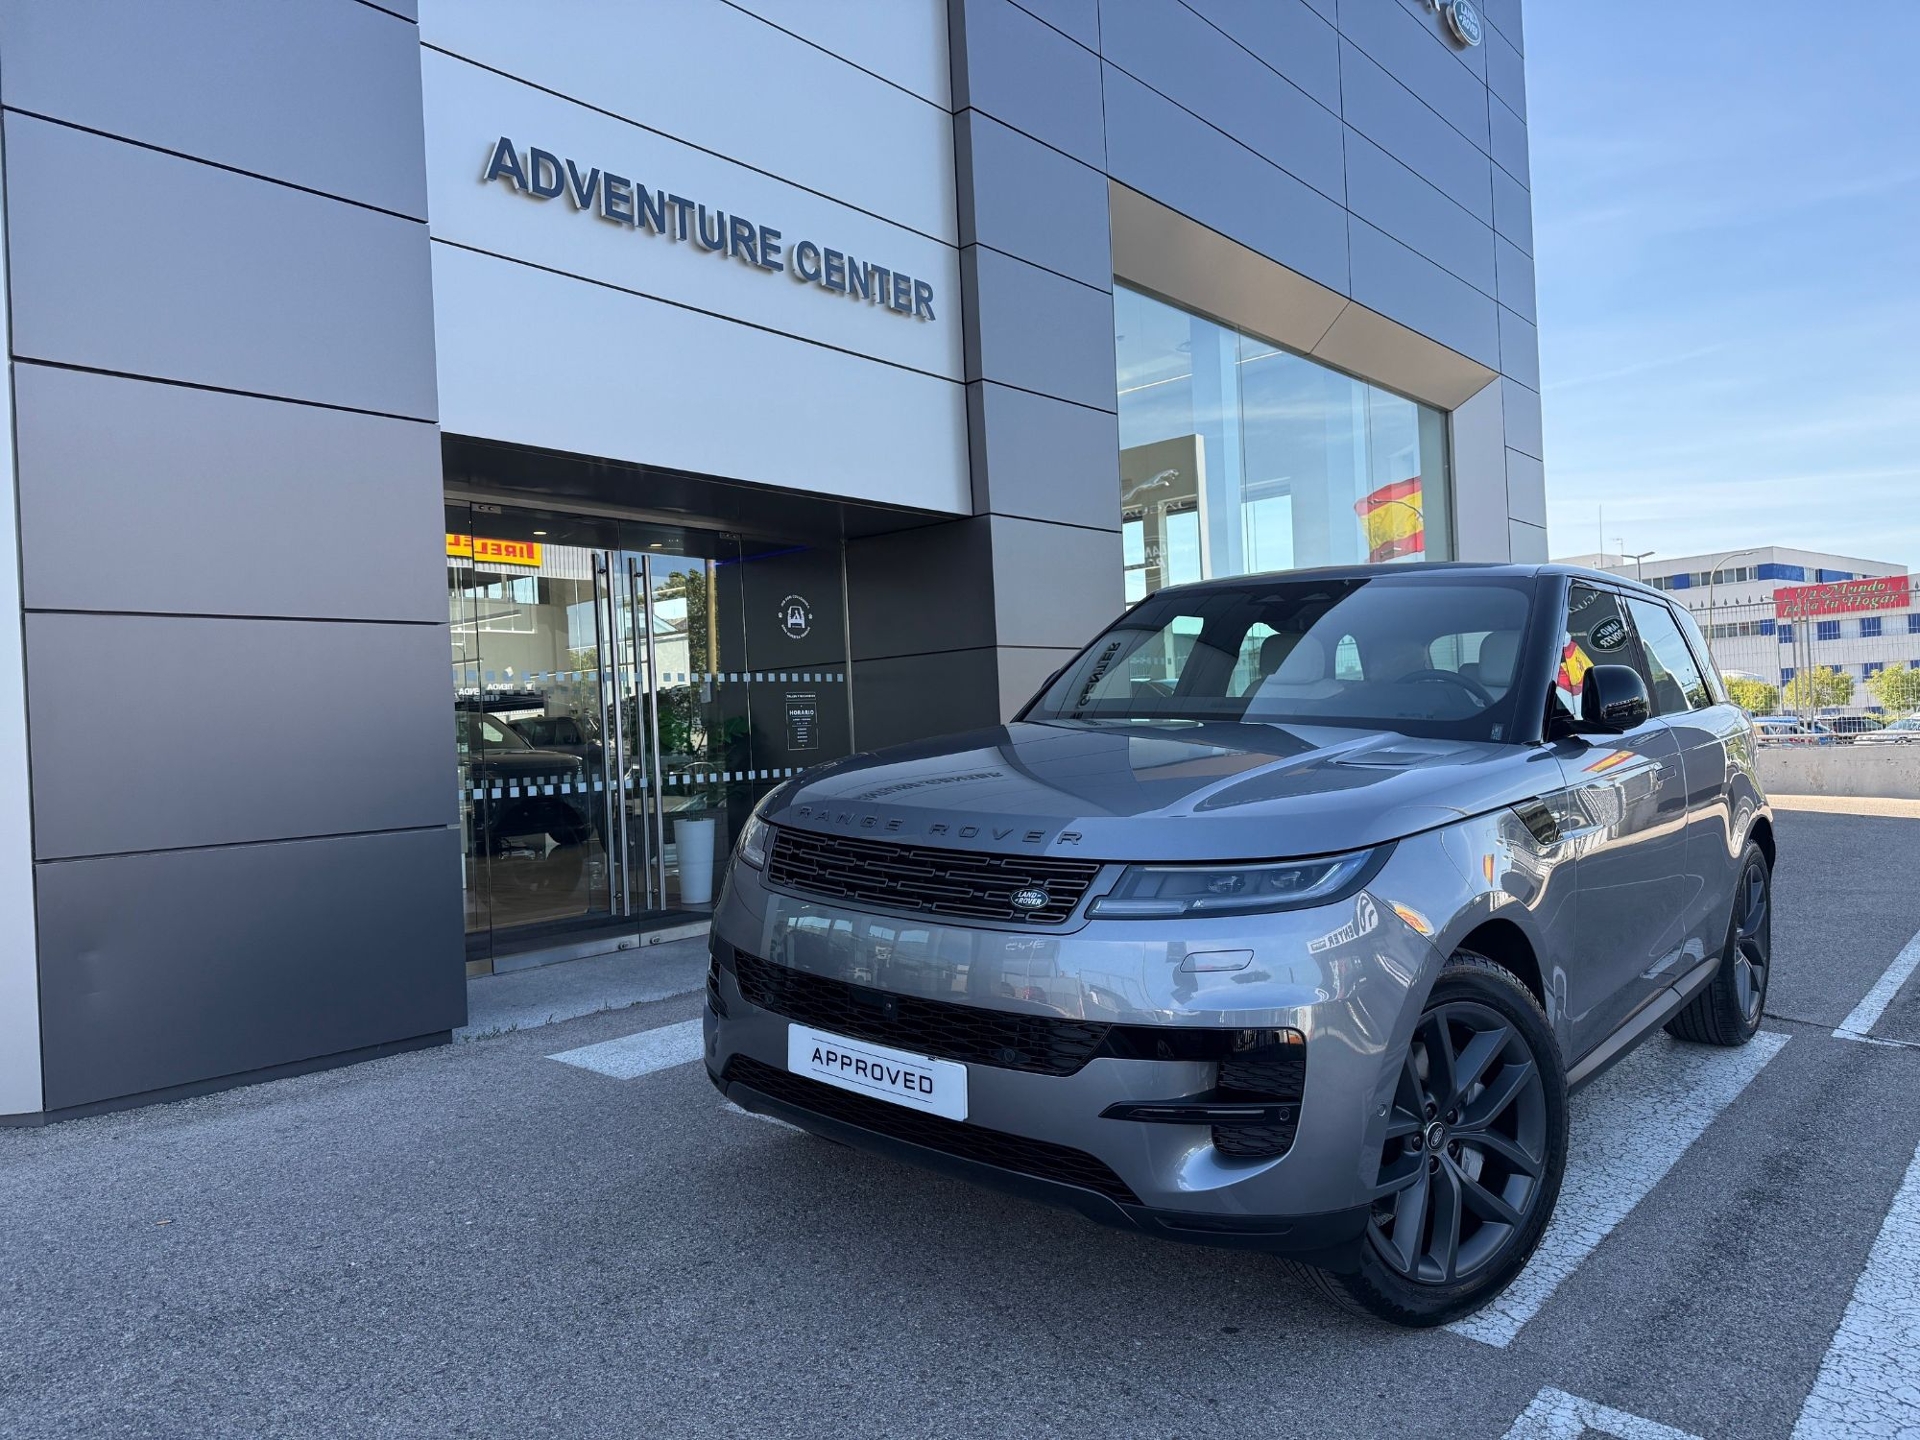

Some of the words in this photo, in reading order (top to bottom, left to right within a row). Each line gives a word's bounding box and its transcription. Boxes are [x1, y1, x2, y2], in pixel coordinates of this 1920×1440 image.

[484, 136, 784, 272] ADVENTURE
[793, 240, 936, 321] CENTER
[1820, 580, 1886, 599] Mundo
[1824, 600, 1839, 609] tu
[1843, 594, 1898, 608] Hogar
[799, 805, 904, 832] RANGE
[929, 823, 1083, 846] ROVER
[1018, 891, 1038, 899] LAND
[1018, 897, 1042, 905] ROVER
[811, 1047, 934, 1095] APPROVED
